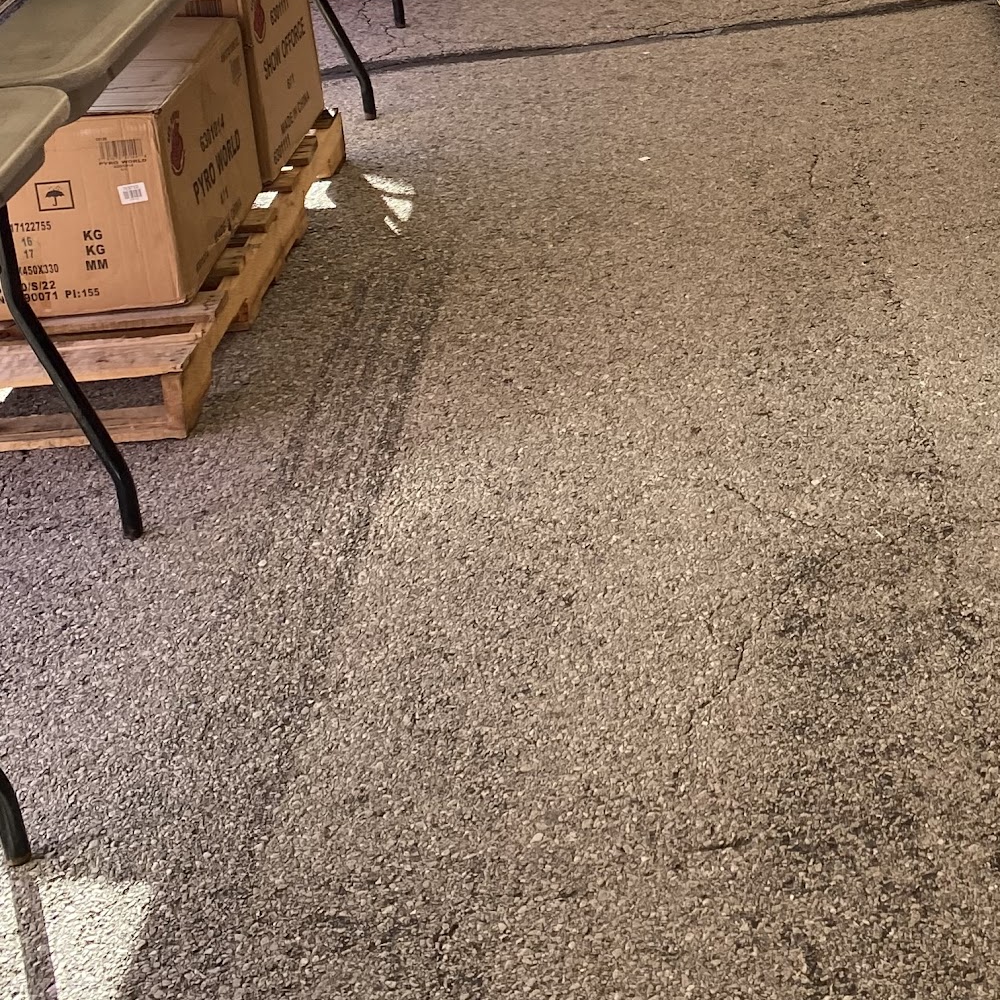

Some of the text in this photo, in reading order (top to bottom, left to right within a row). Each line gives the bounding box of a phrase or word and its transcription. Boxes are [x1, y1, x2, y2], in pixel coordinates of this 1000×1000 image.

[262, 42, 282, 80] SHOW
[192, 128, 241, 206] PYRO WORLD
[21, 229, 103, 247] 16 KG
[23, 244, 106, 260] 17 KG
[86, 258, 109, 271] MM
